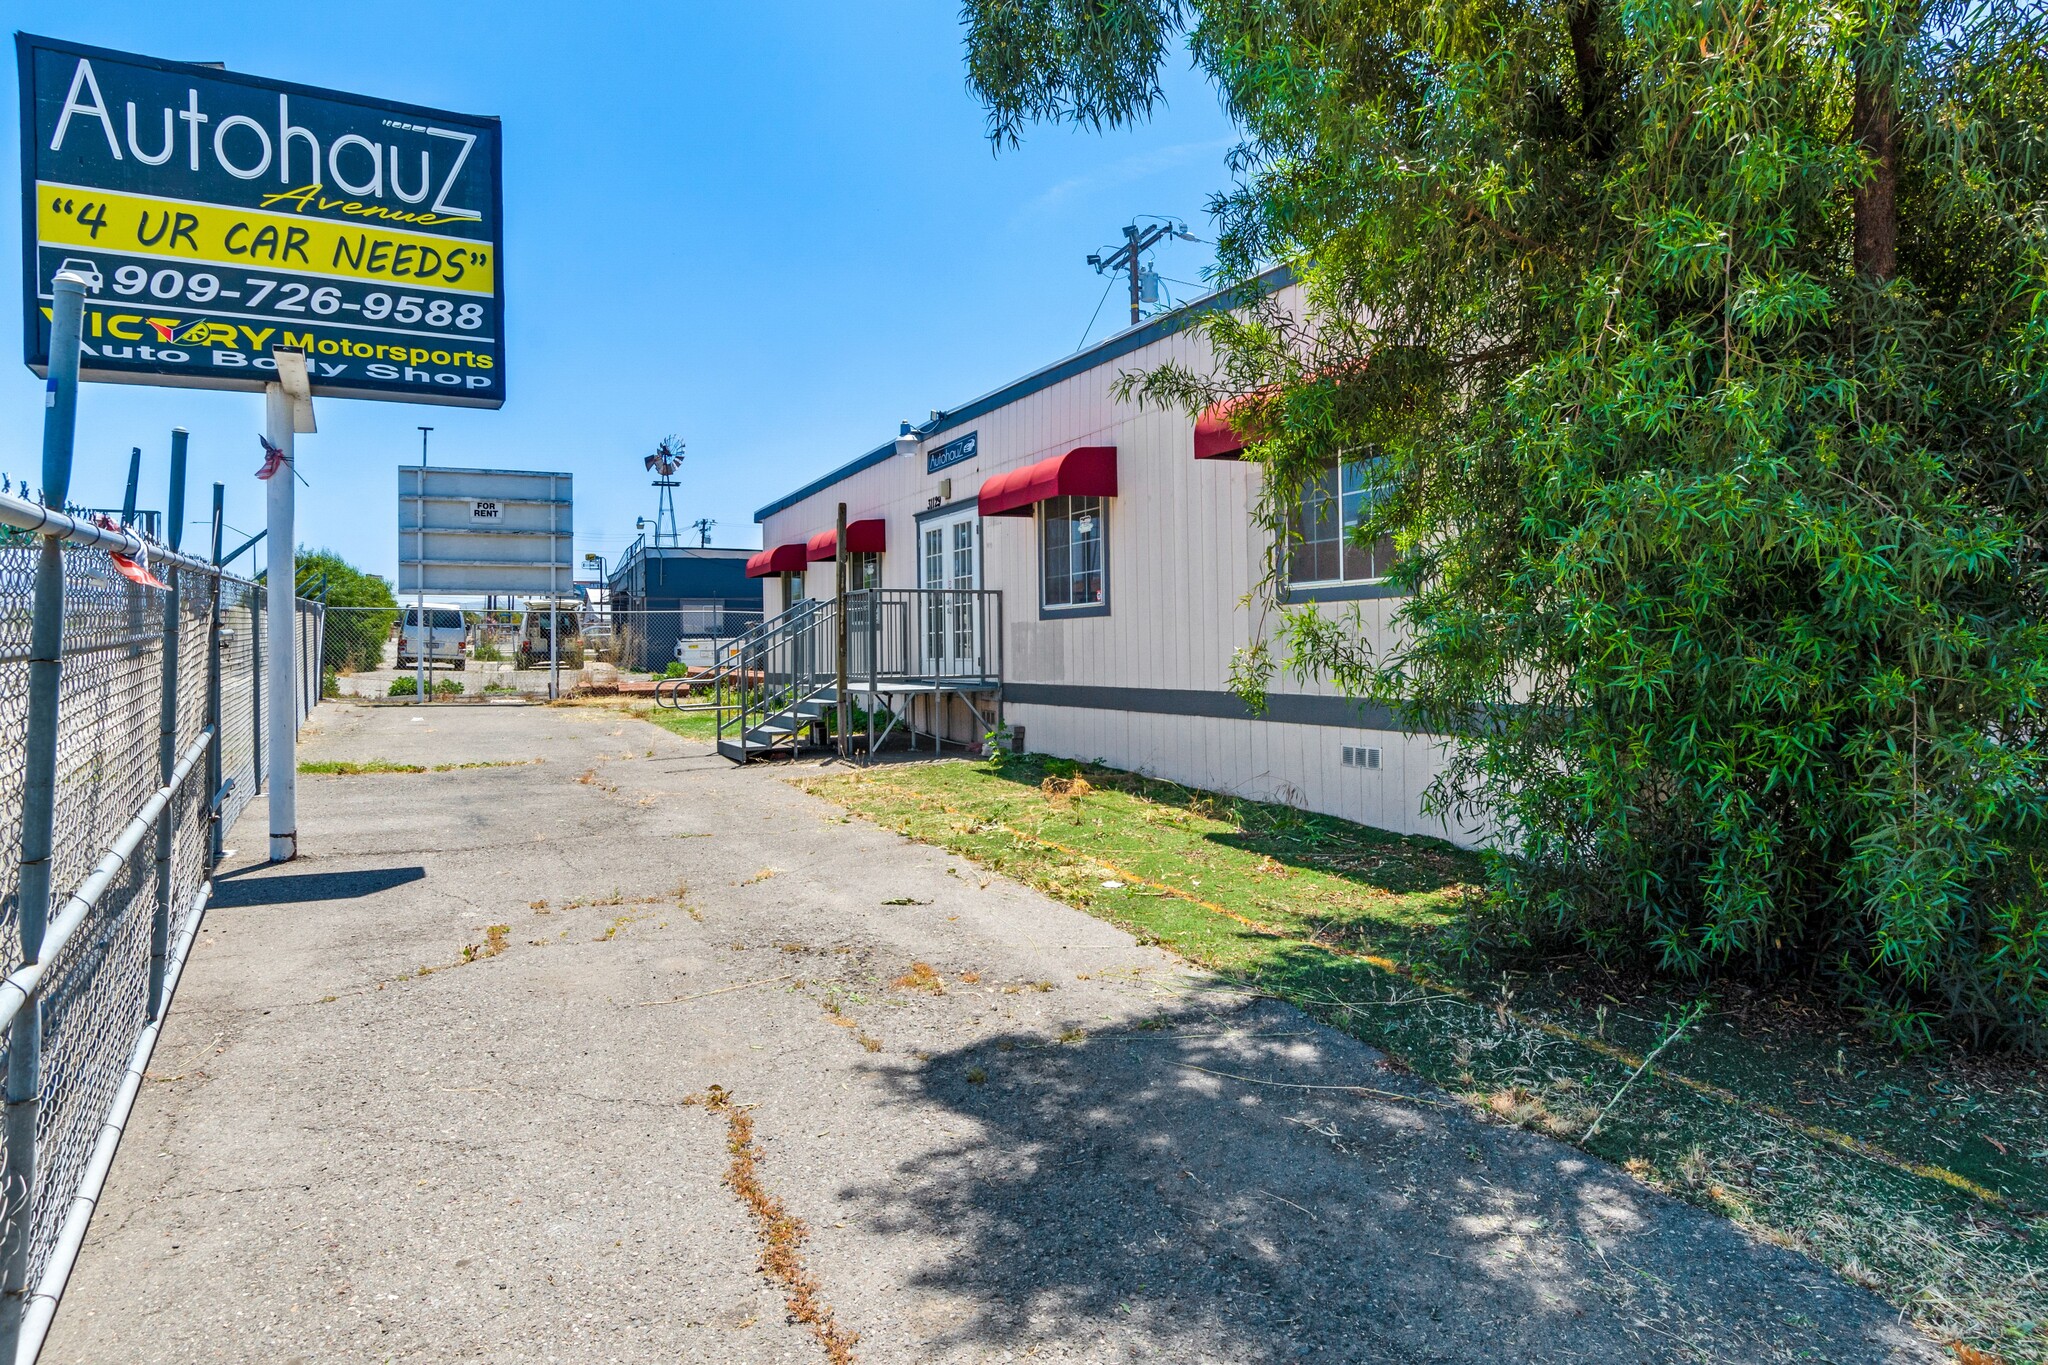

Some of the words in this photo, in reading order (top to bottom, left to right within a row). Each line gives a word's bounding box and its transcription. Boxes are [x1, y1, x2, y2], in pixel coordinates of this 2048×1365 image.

[259, 183, 482, 225] Avenue
[137, 210, 198, 251] UR
[224, 222, 309, 264] CAR
[333, 234, 487, 282] NEEDS”
[112, 265, 484, 330] 909-726-9588
[283, 331, 494, 369] Motorsports
[365, 363, 492, 389] Shop
[474, 509, 499, 518] RENT
[477, 502, 496, 510] FOR
